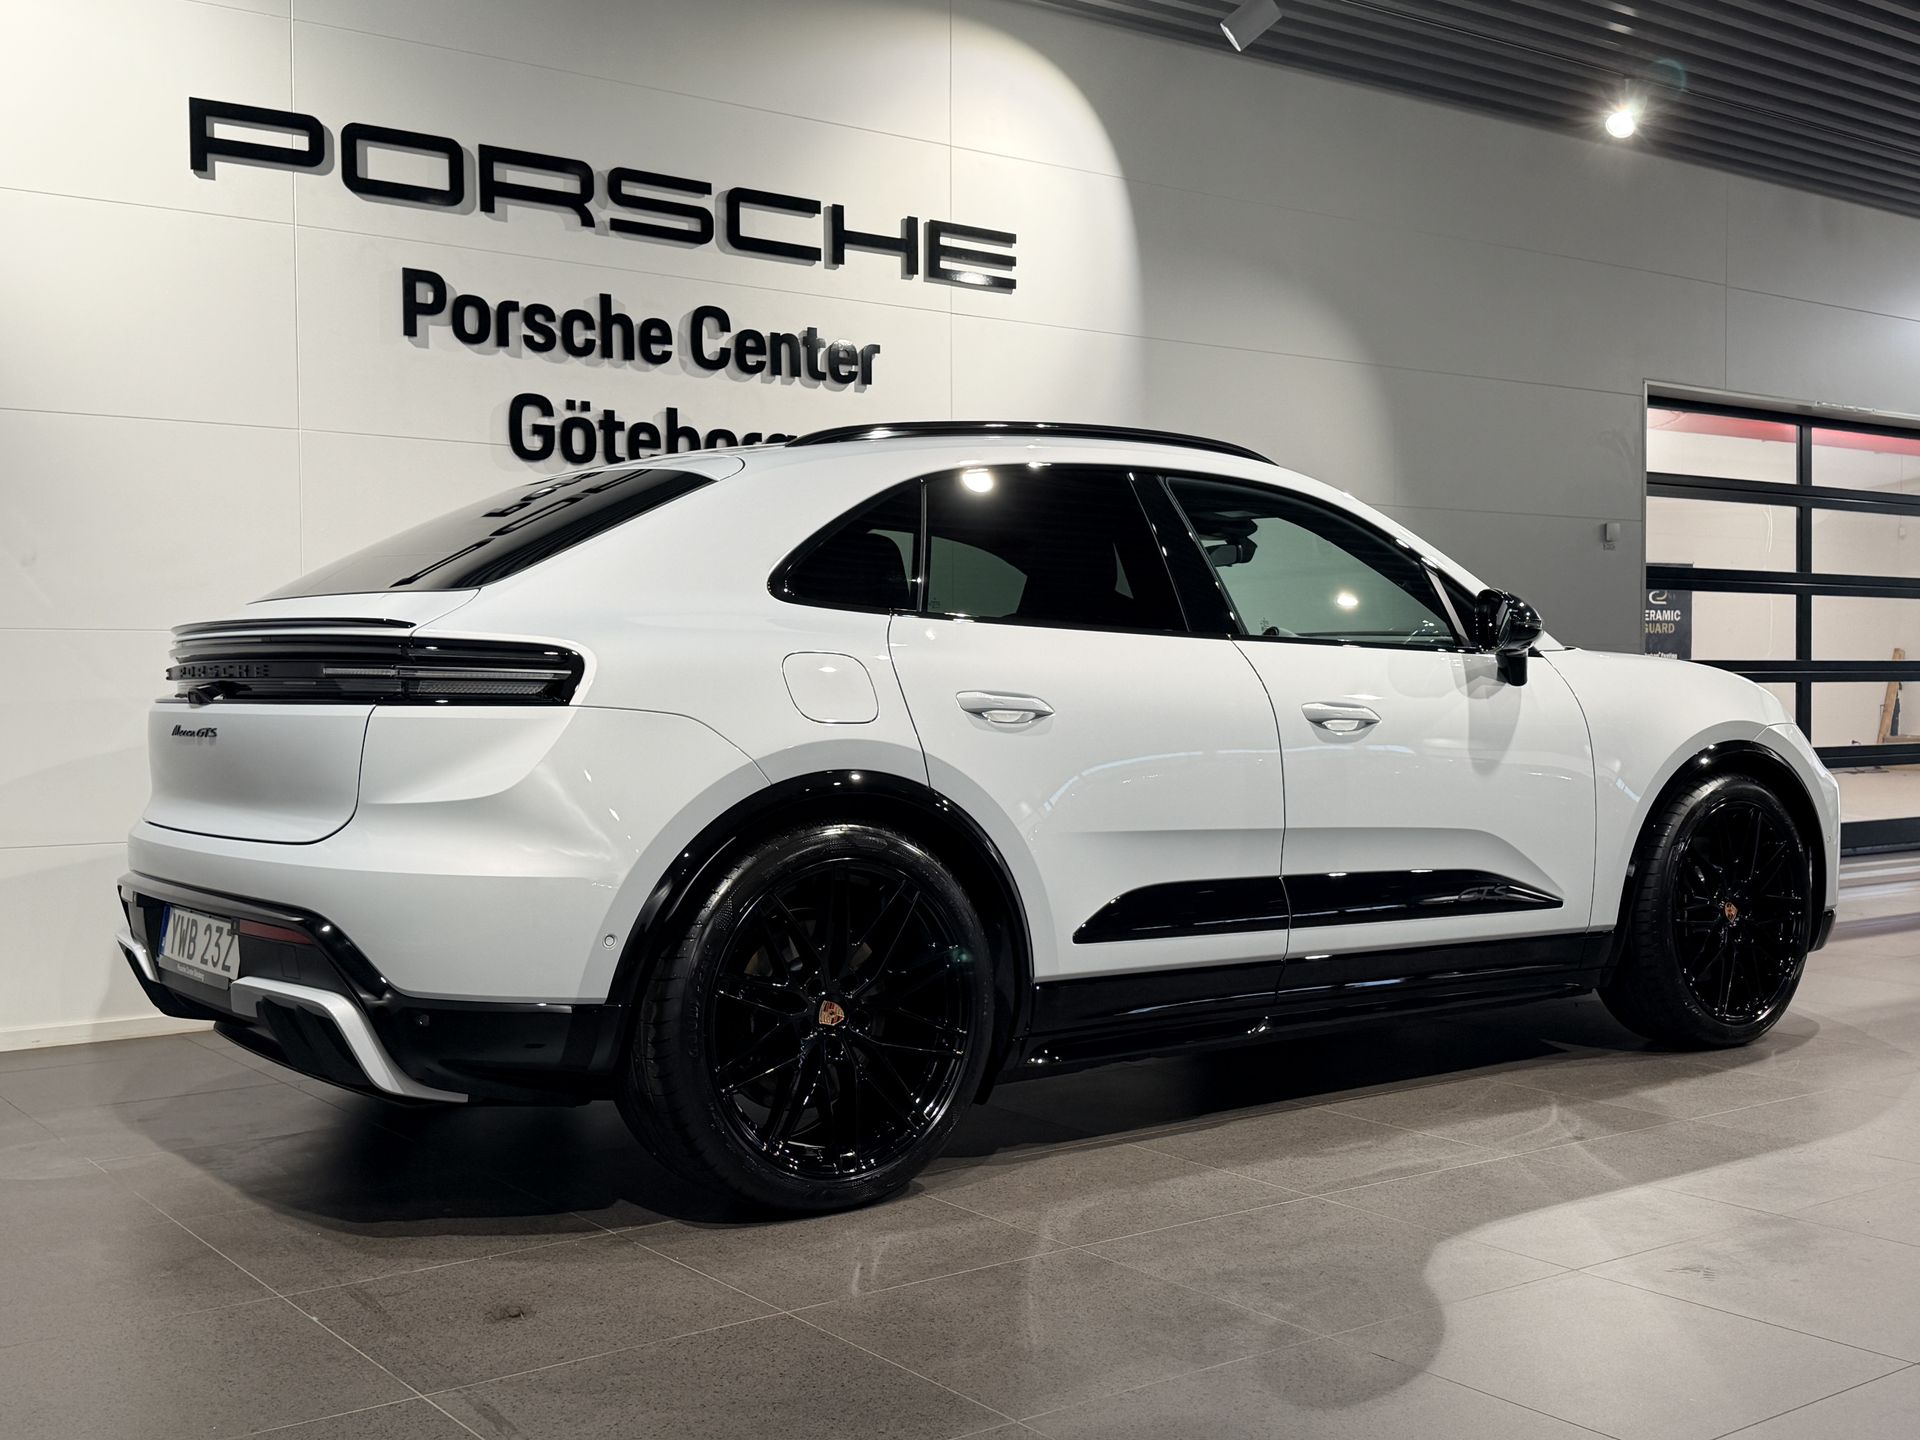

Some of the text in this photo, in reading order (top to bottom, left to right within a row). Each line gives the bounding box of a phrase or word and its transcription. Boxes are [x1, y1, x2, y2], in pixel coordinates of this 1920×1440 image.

[189, 97, 1017, 290] PORSCHE
[402, 267, 881, 387] Porsche Center
[508, 392, 798, 465] Göteb
[196, 727, 218, 738] GTS
[170, 911, 198, 960] YWB
